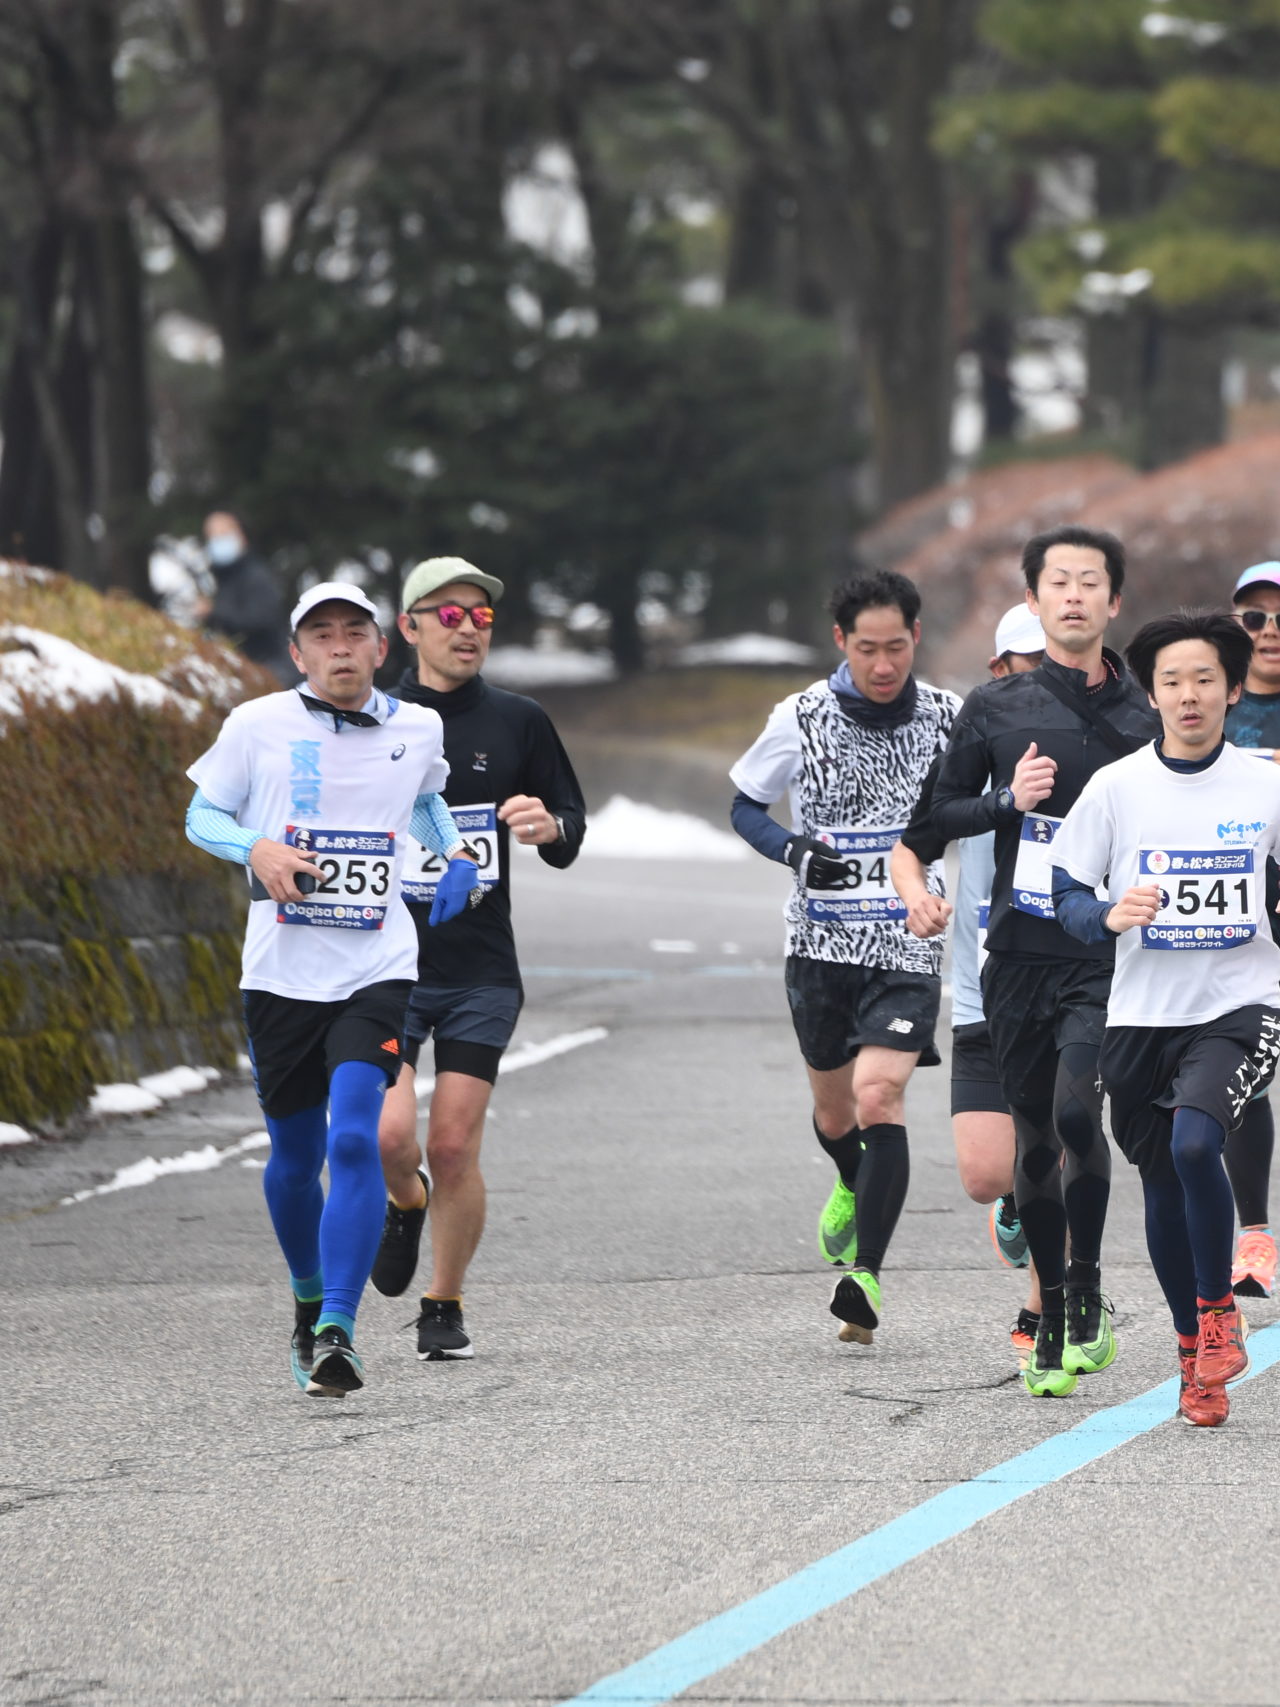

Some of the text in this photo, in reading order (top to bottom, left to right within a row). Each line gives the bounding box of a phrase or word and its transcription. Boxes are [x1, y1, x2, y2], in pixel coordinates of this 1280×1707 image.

[421, 837, 492, 873] 20
[1172, 856, 1214, 870] 春の松本
[317, 859, 390, 896] 253
[1176, 879, 1248, 915] 541
[1147, 926, 1250, 941] Nagisa Life Site
